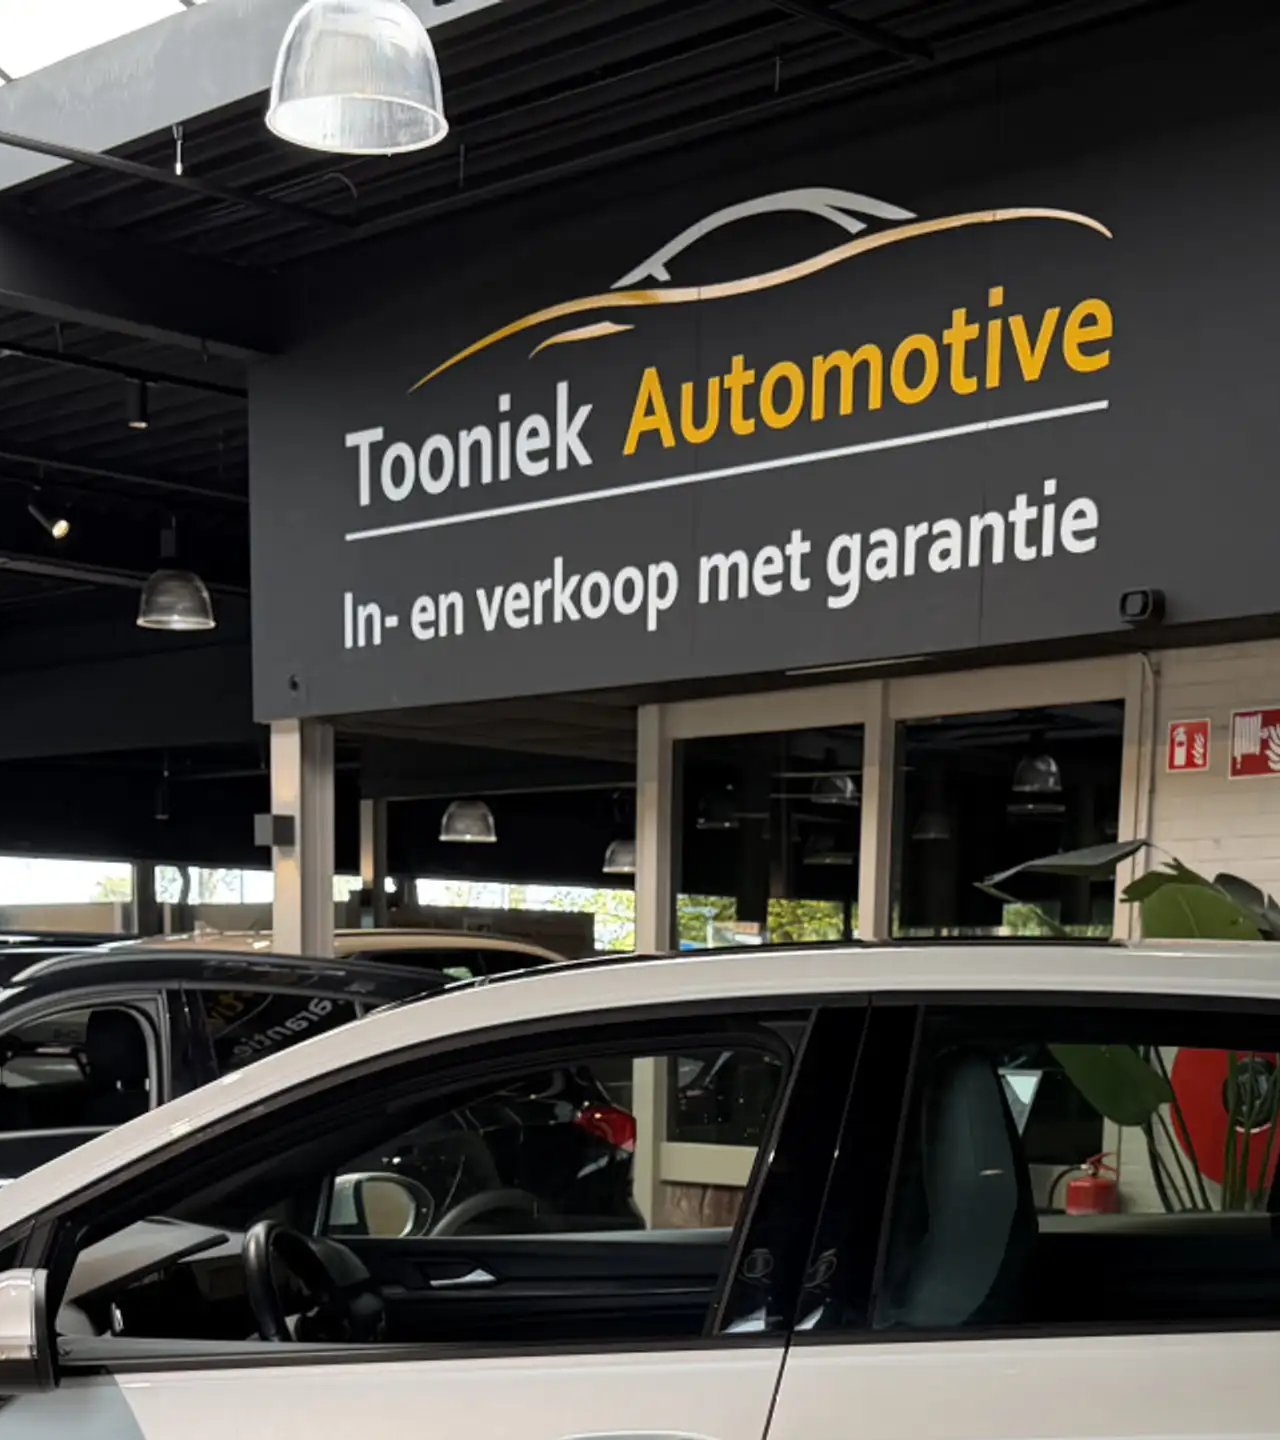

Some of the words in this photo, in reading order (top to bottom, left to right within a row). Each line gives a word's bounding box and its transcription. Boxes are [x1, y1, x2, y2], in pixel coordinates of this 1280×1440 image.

[346, 381, 593, 507] Tooniek
[622, 285, 1113, 456] Automotive
[343, 591, 399, 650] In-
[410, 591, 464, 641] en
[475, 555, 679, 632] verkoop
[698, 528, 812, 605] met
[826, 478, 1099, 610] garantie
